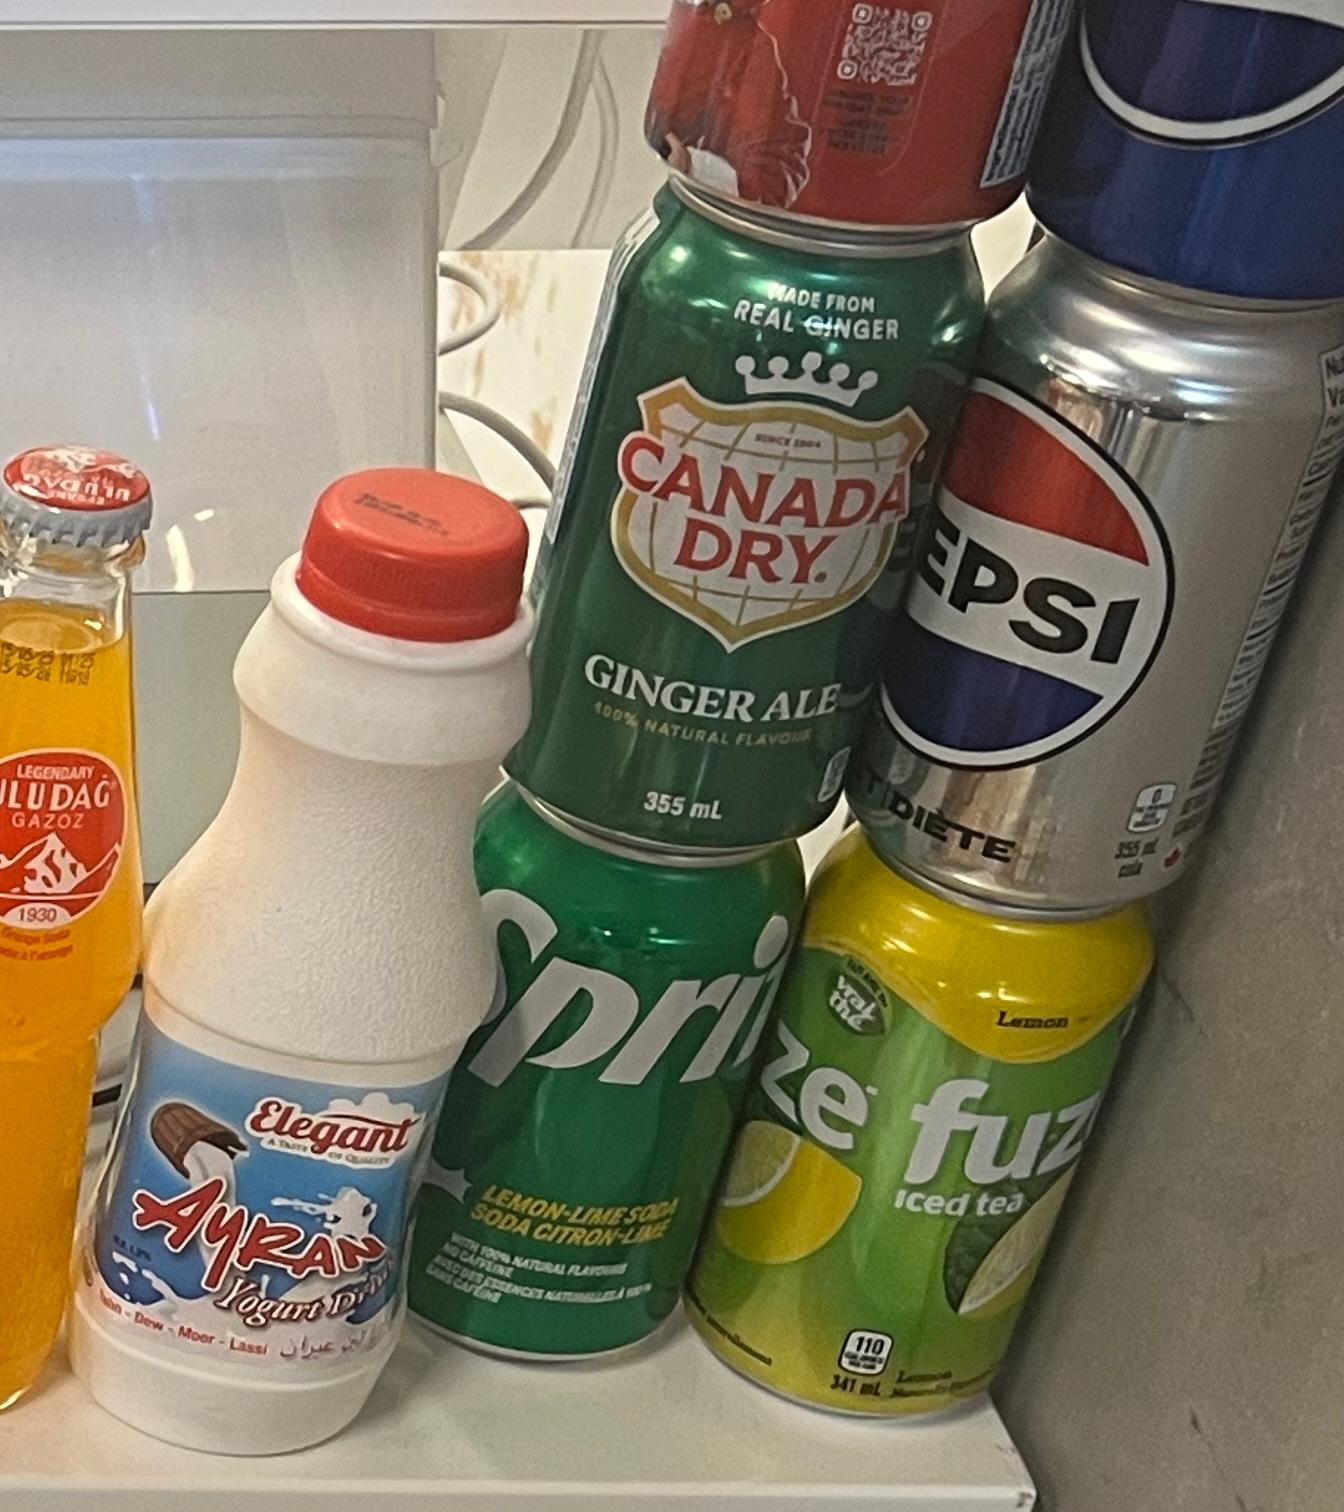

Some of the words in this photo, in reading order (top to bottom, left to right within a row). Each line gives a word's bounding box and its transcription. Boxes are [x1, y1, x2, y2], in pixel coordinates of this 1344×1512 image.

[734, 300, 794, 333] REAL
[804, 315, 899, 340] GINGER
[768, 283, 821, 308] MADE
[826, 294, 875, 313] FROM
[620, 436, 910, 530] CANADA
[673, 515, 837, 585] DRY
[917, 512, 1141, 666] EPSI
[583, 654, 756, 723] GINGER
[760, 682, 843, 722] ALE
[594, 701, 639, 728] 100%
[644, 719, 730, 746] NATURAL
[16, 763, 96, 781] LEGENDARY
[11, 811, 85, 830] GAZOZ
[644, 791, 687, 816] 355
[689, 799, 723, 820] mL
[887, 790, 1017, 864] DIÈTE
[18, 908, 58, 923] 1930
[467, 889, 789, 1088] Spri
[996, 1010, 1070, 1029] Lemon
[759, 1018, 869, 1150] ze
[903, 1078, 1102, 1186] fuz
[249, 1100, 424, 1154] Elegant
[470, 1202, 533, 1237] SODA
[533, 1218, 673, 1248] CITRON-LIME
[480, 1184, 628, 1226] LEMON-LIME
[624, 1197, 680, 1226] SODA
[894, 1188, 967, 1218] iced
[976, 1189, 1025, 1218] tea
[134, 1178, 386, 1290] AYRAN
[213, 1276, 325, 1329] Yogurt
[177, 1325, 216, 1345] Moor
[228, 1335, 269, 1356] Lassi
[856, 1335, 886, 1356] 110
